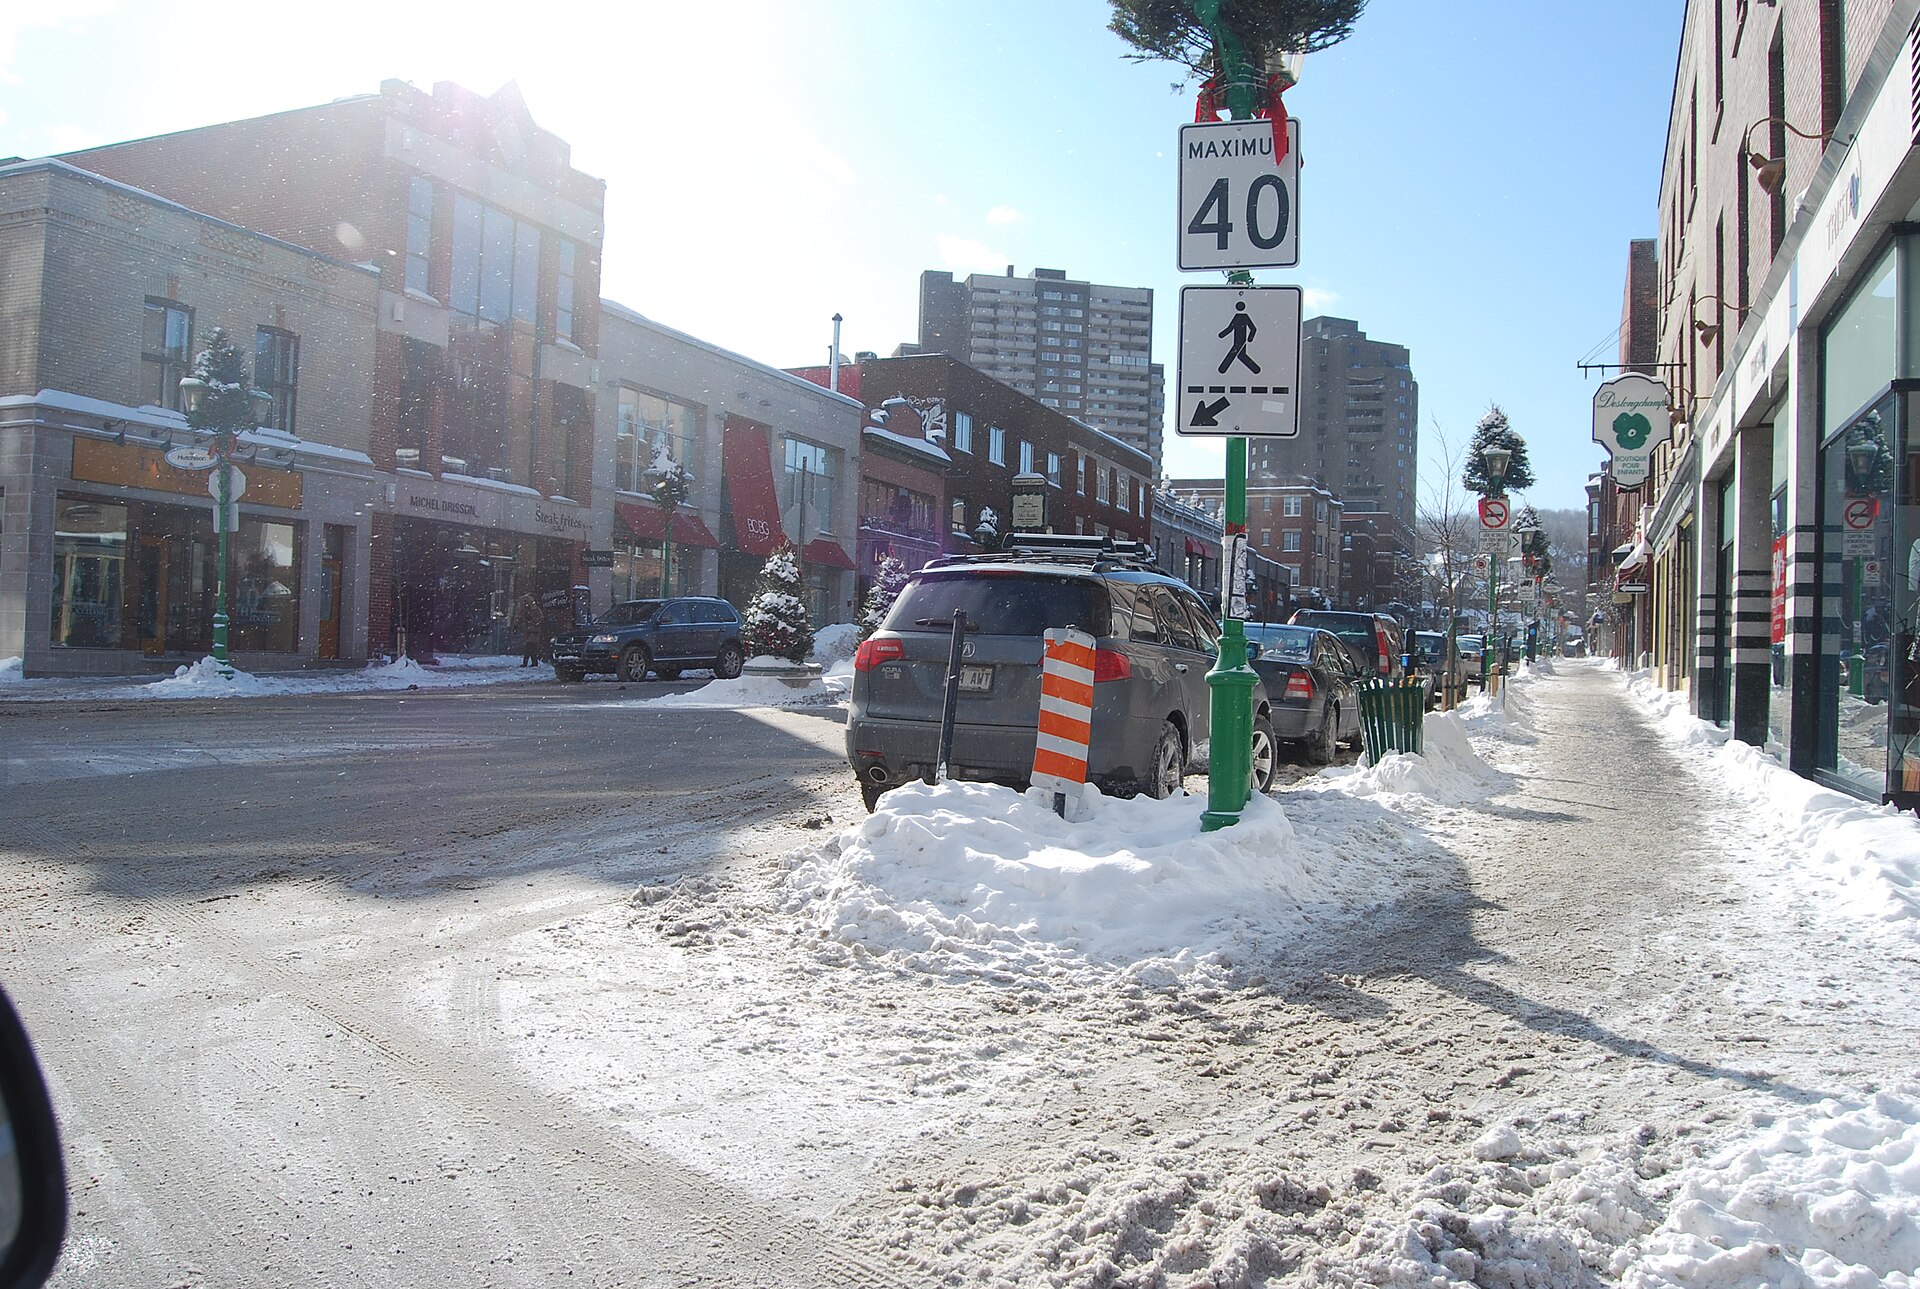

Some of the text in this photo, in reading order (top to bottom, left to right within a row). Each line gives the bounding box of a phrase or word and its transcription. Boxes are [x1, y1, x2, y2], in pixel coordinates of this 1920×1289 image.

[1187, 173, 1290, 251] 40
[410, 495, 476, 516] MICHEL BRISSON
[535, 509, 558, 525] Steak
[559, 512, 582, 529] frites
[746, 517, 770, 536] BCBG
